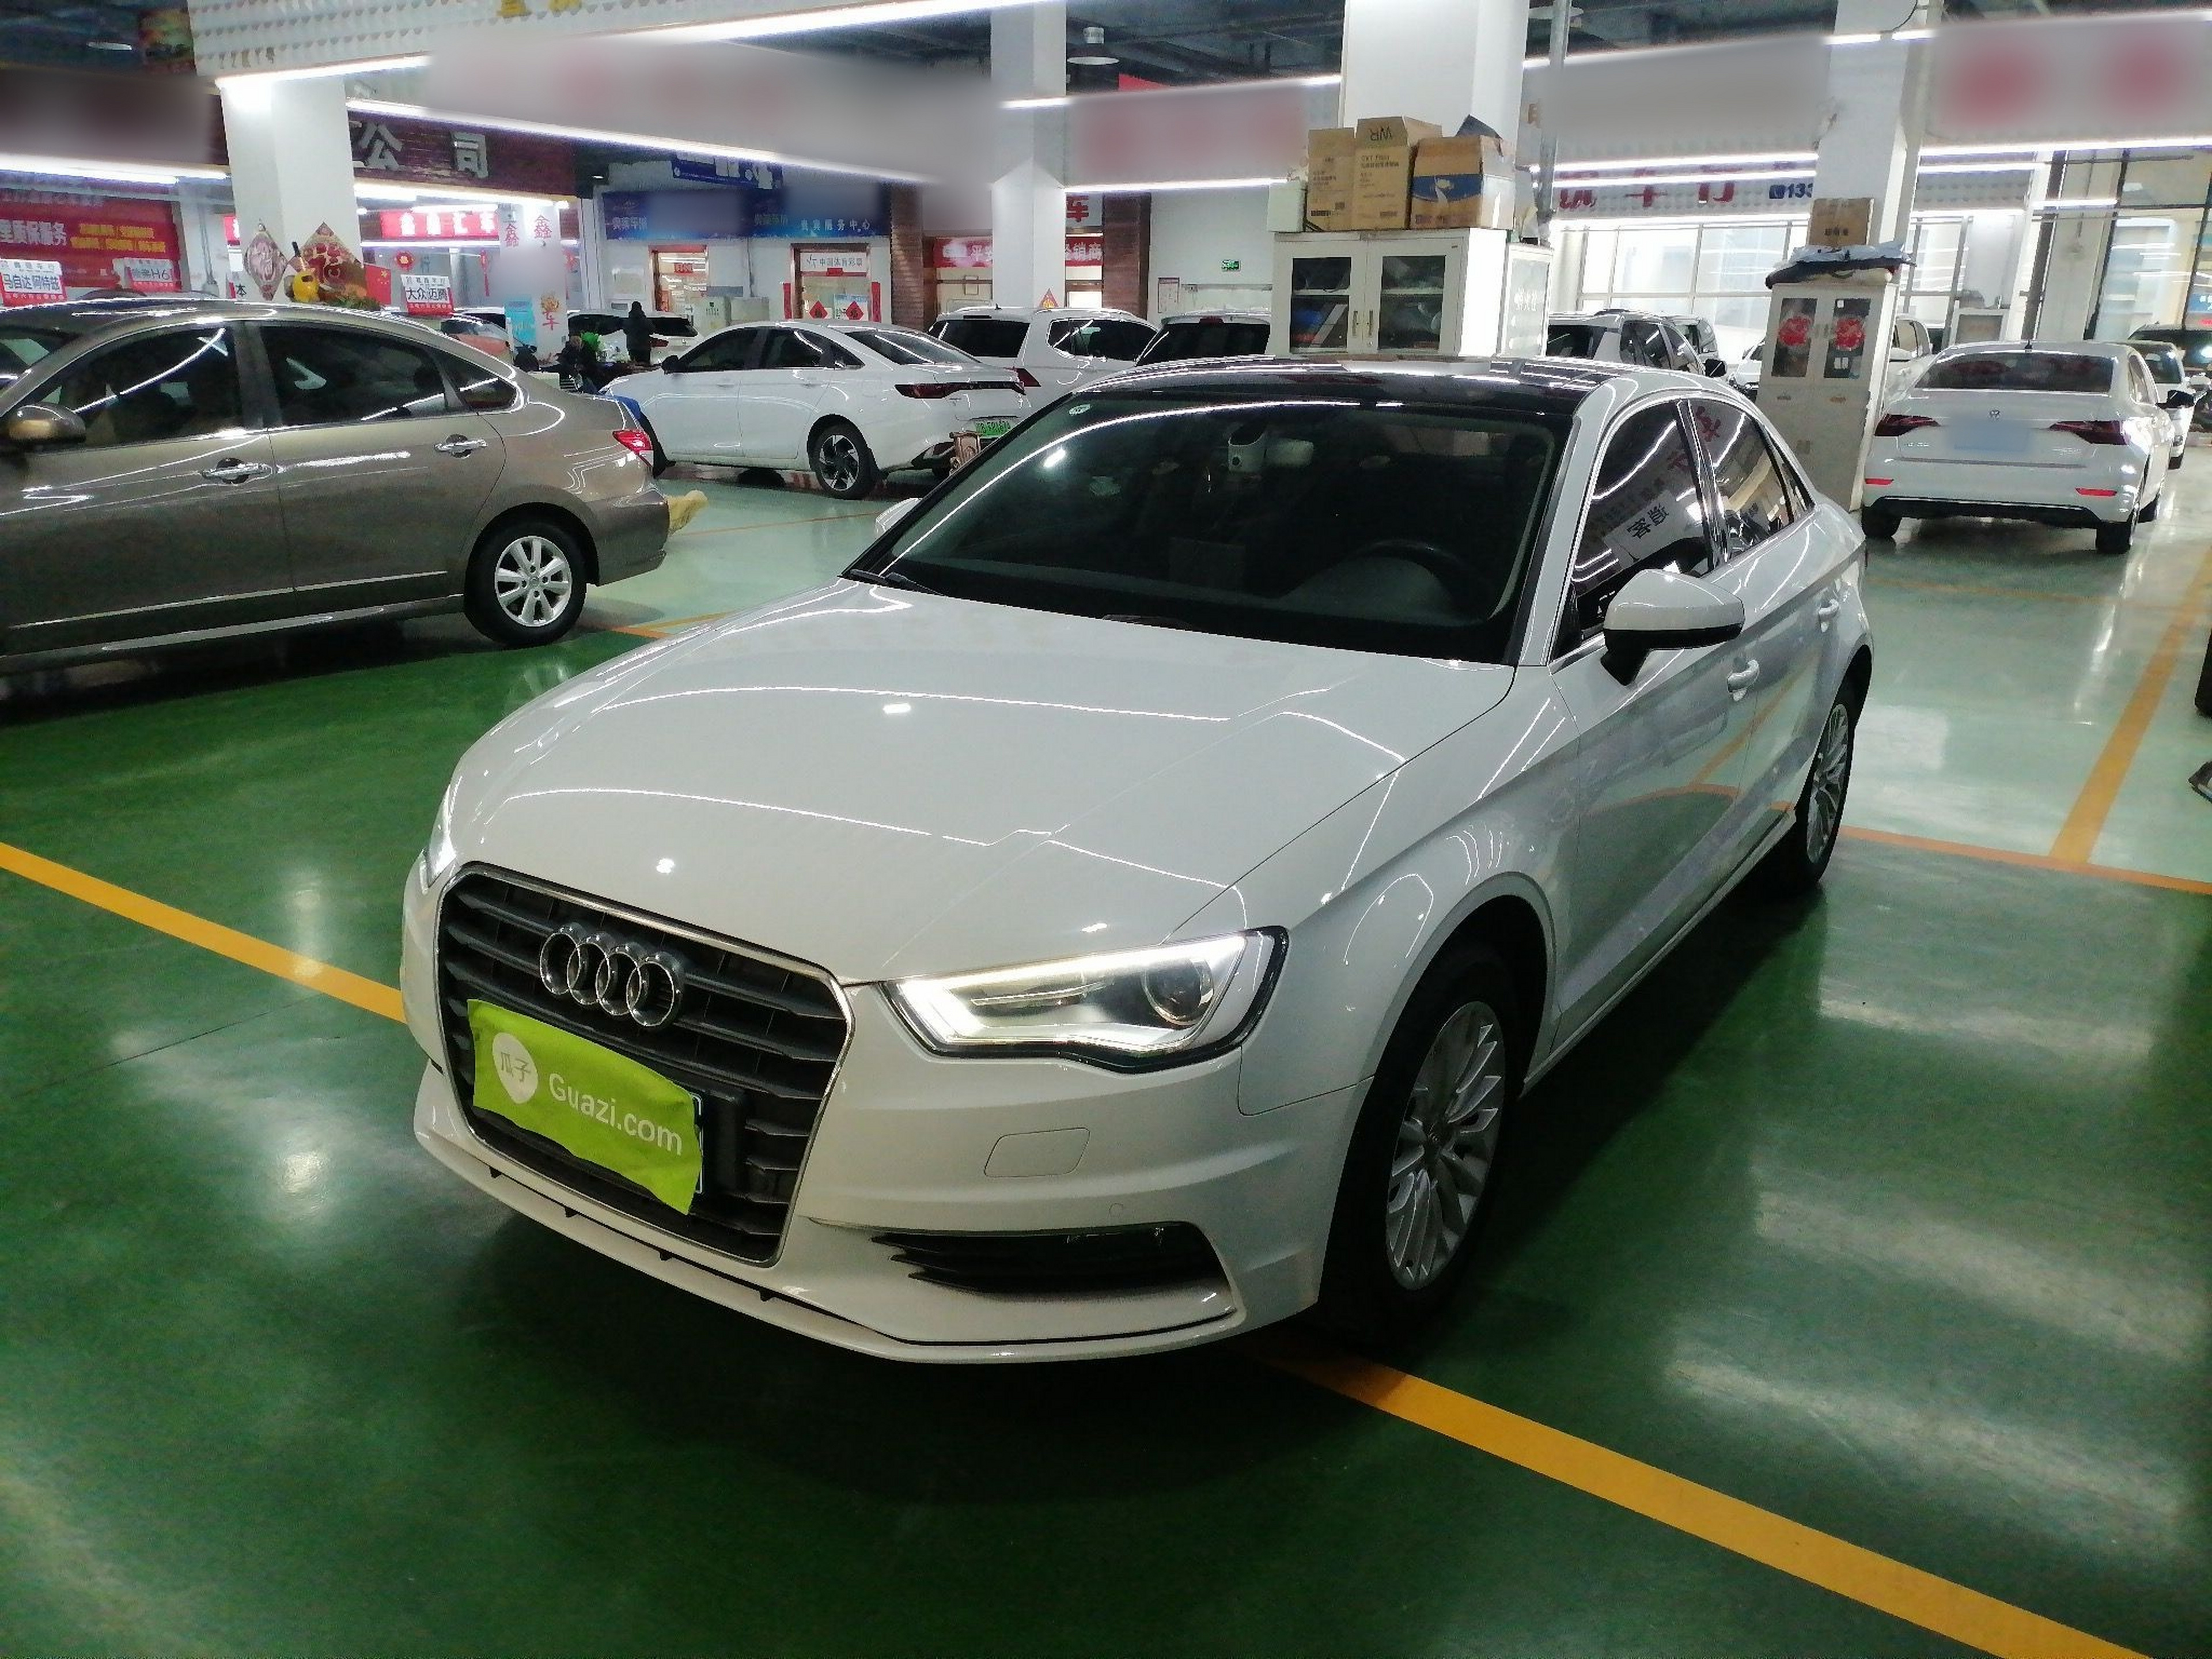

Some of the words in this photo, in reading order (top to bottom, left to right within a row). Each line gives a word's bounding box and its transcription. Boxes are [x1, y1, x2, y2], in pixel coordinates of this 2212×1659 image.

[349, 120, 488, 179] 公司
[500, 1051, 531, 1083] 瓜子
[548, 1072, 684, 1156] Guazi.com
